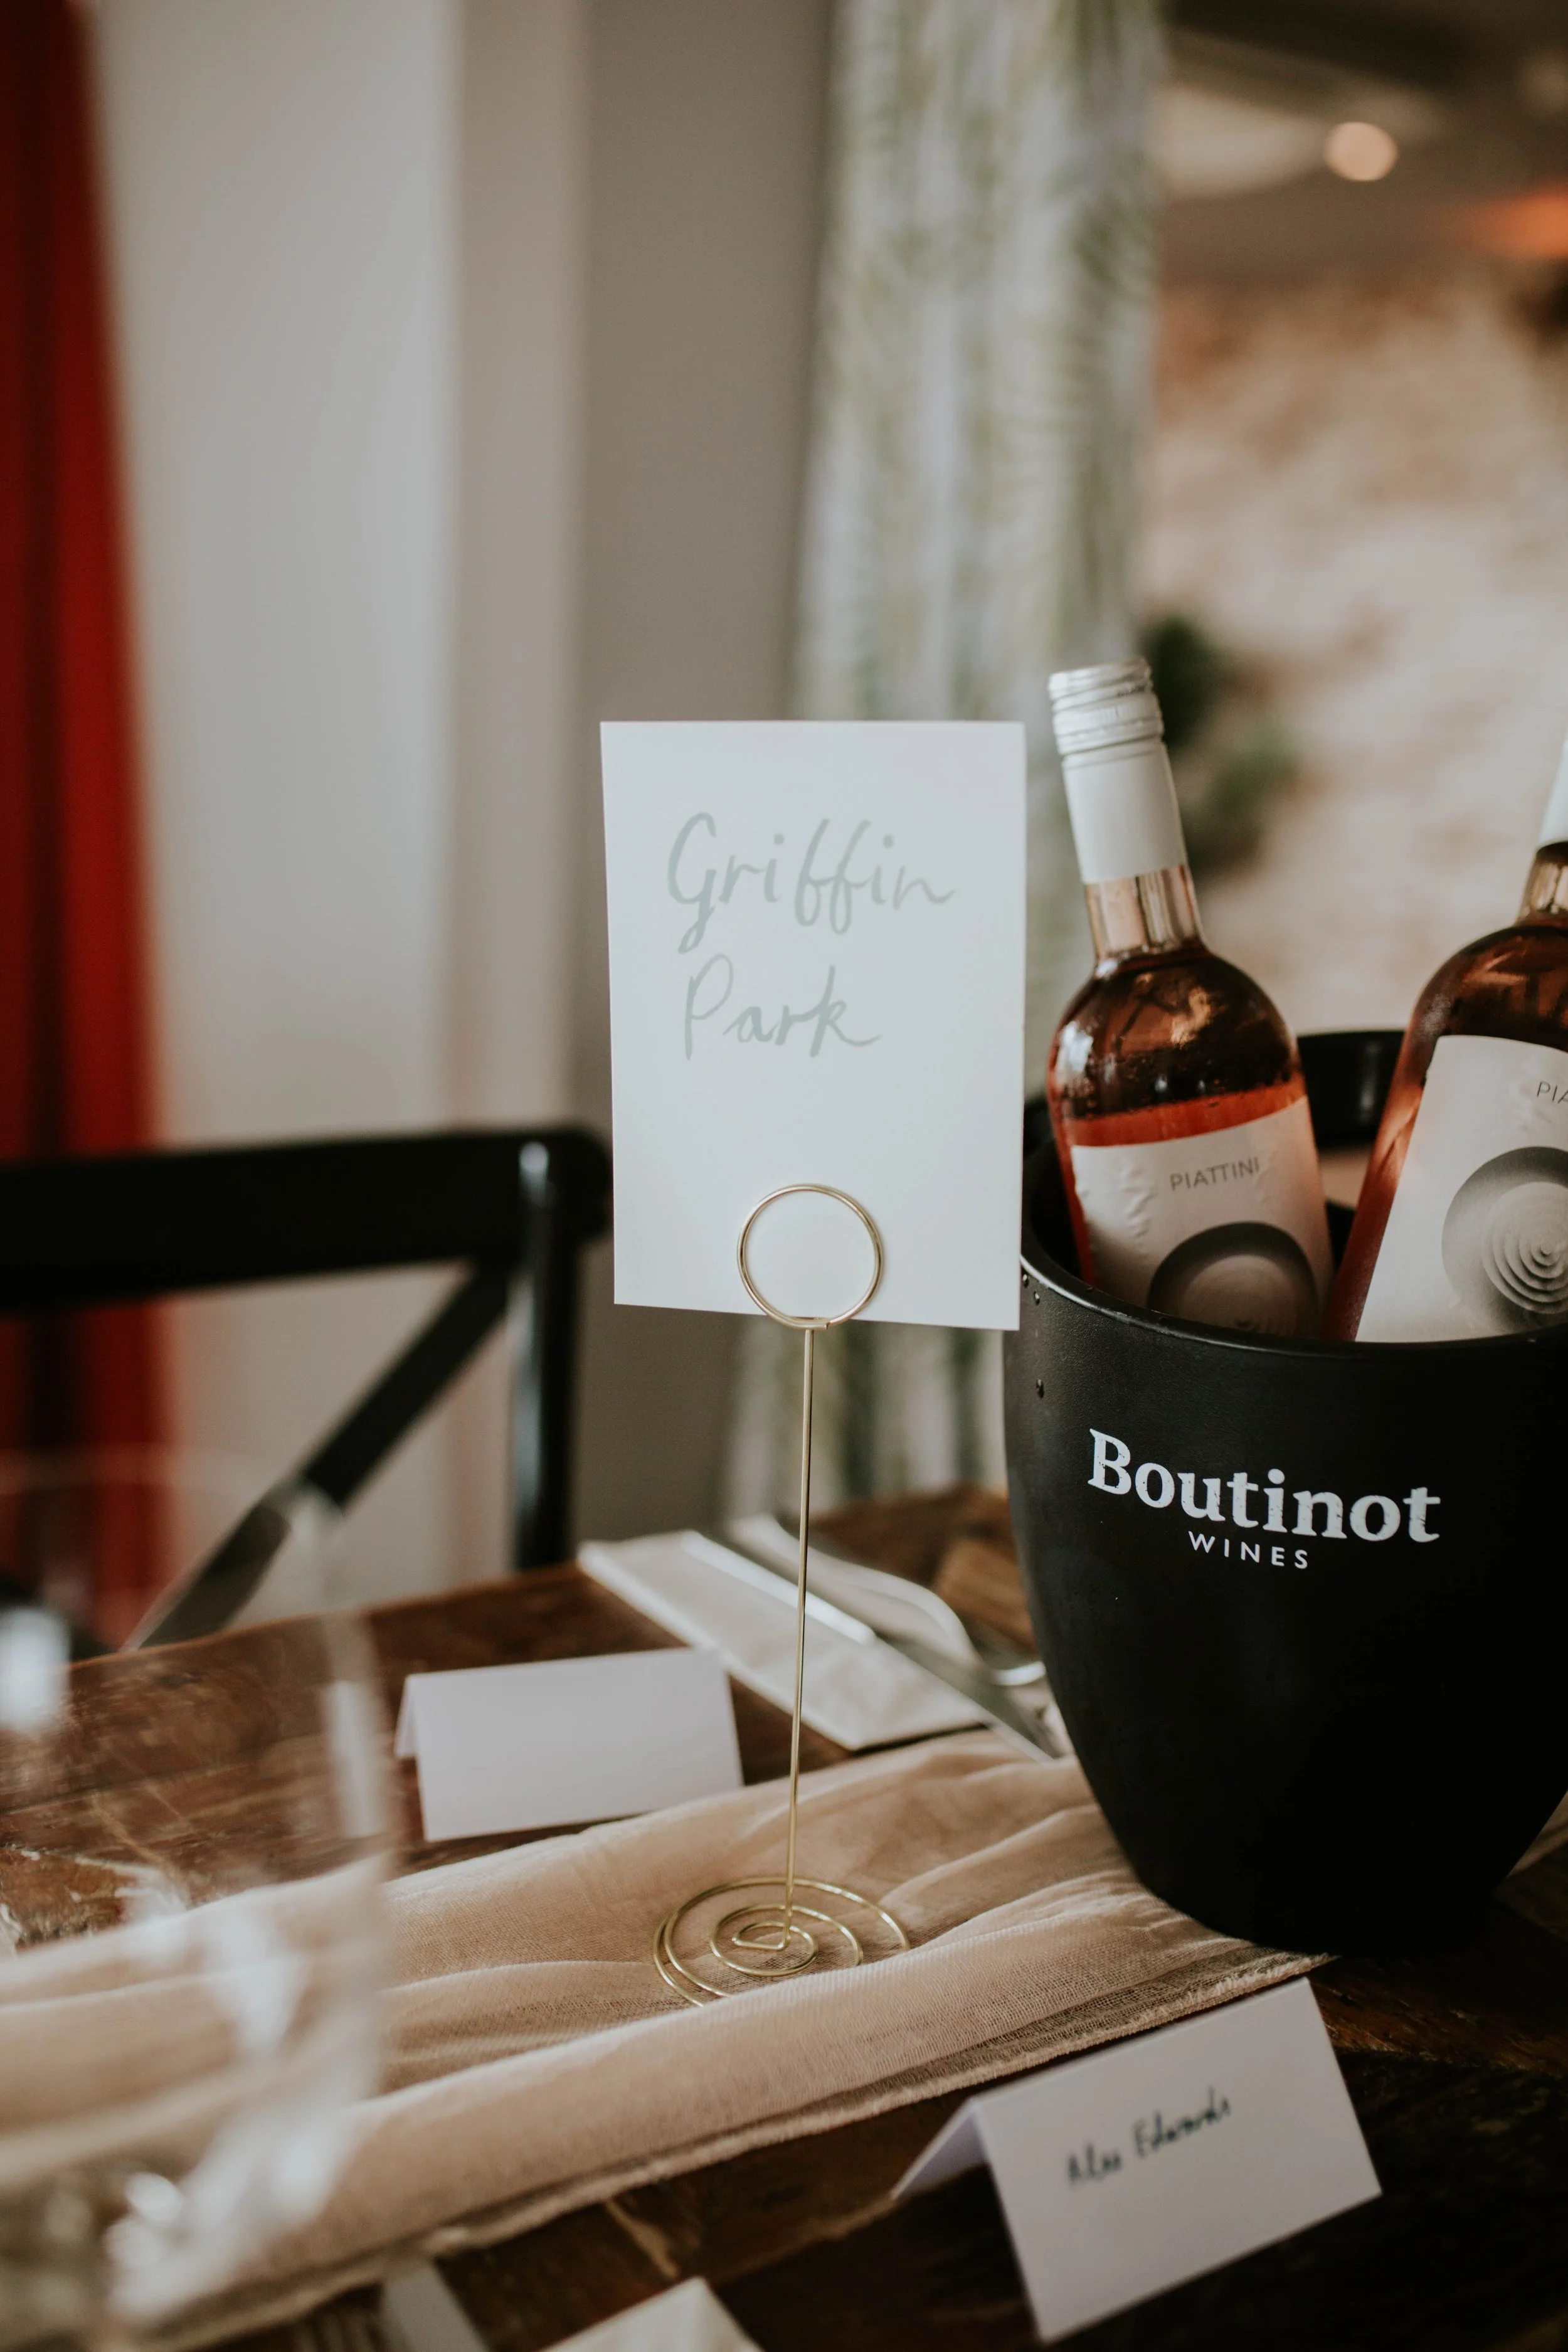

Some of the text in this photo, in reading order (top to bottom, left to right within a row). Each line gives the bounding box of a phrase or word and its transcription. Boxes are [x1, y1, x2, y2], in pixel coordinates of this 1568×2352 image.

[667, 812, 958, 954] Griffin
[684, 953, 881, 1060] Park
[1170, 1156, 1260, 1191] PIATTINI
[1087, 1428, 1441, 1543] Boutinot
[1188, 1530, 1308, 1569] WINES
